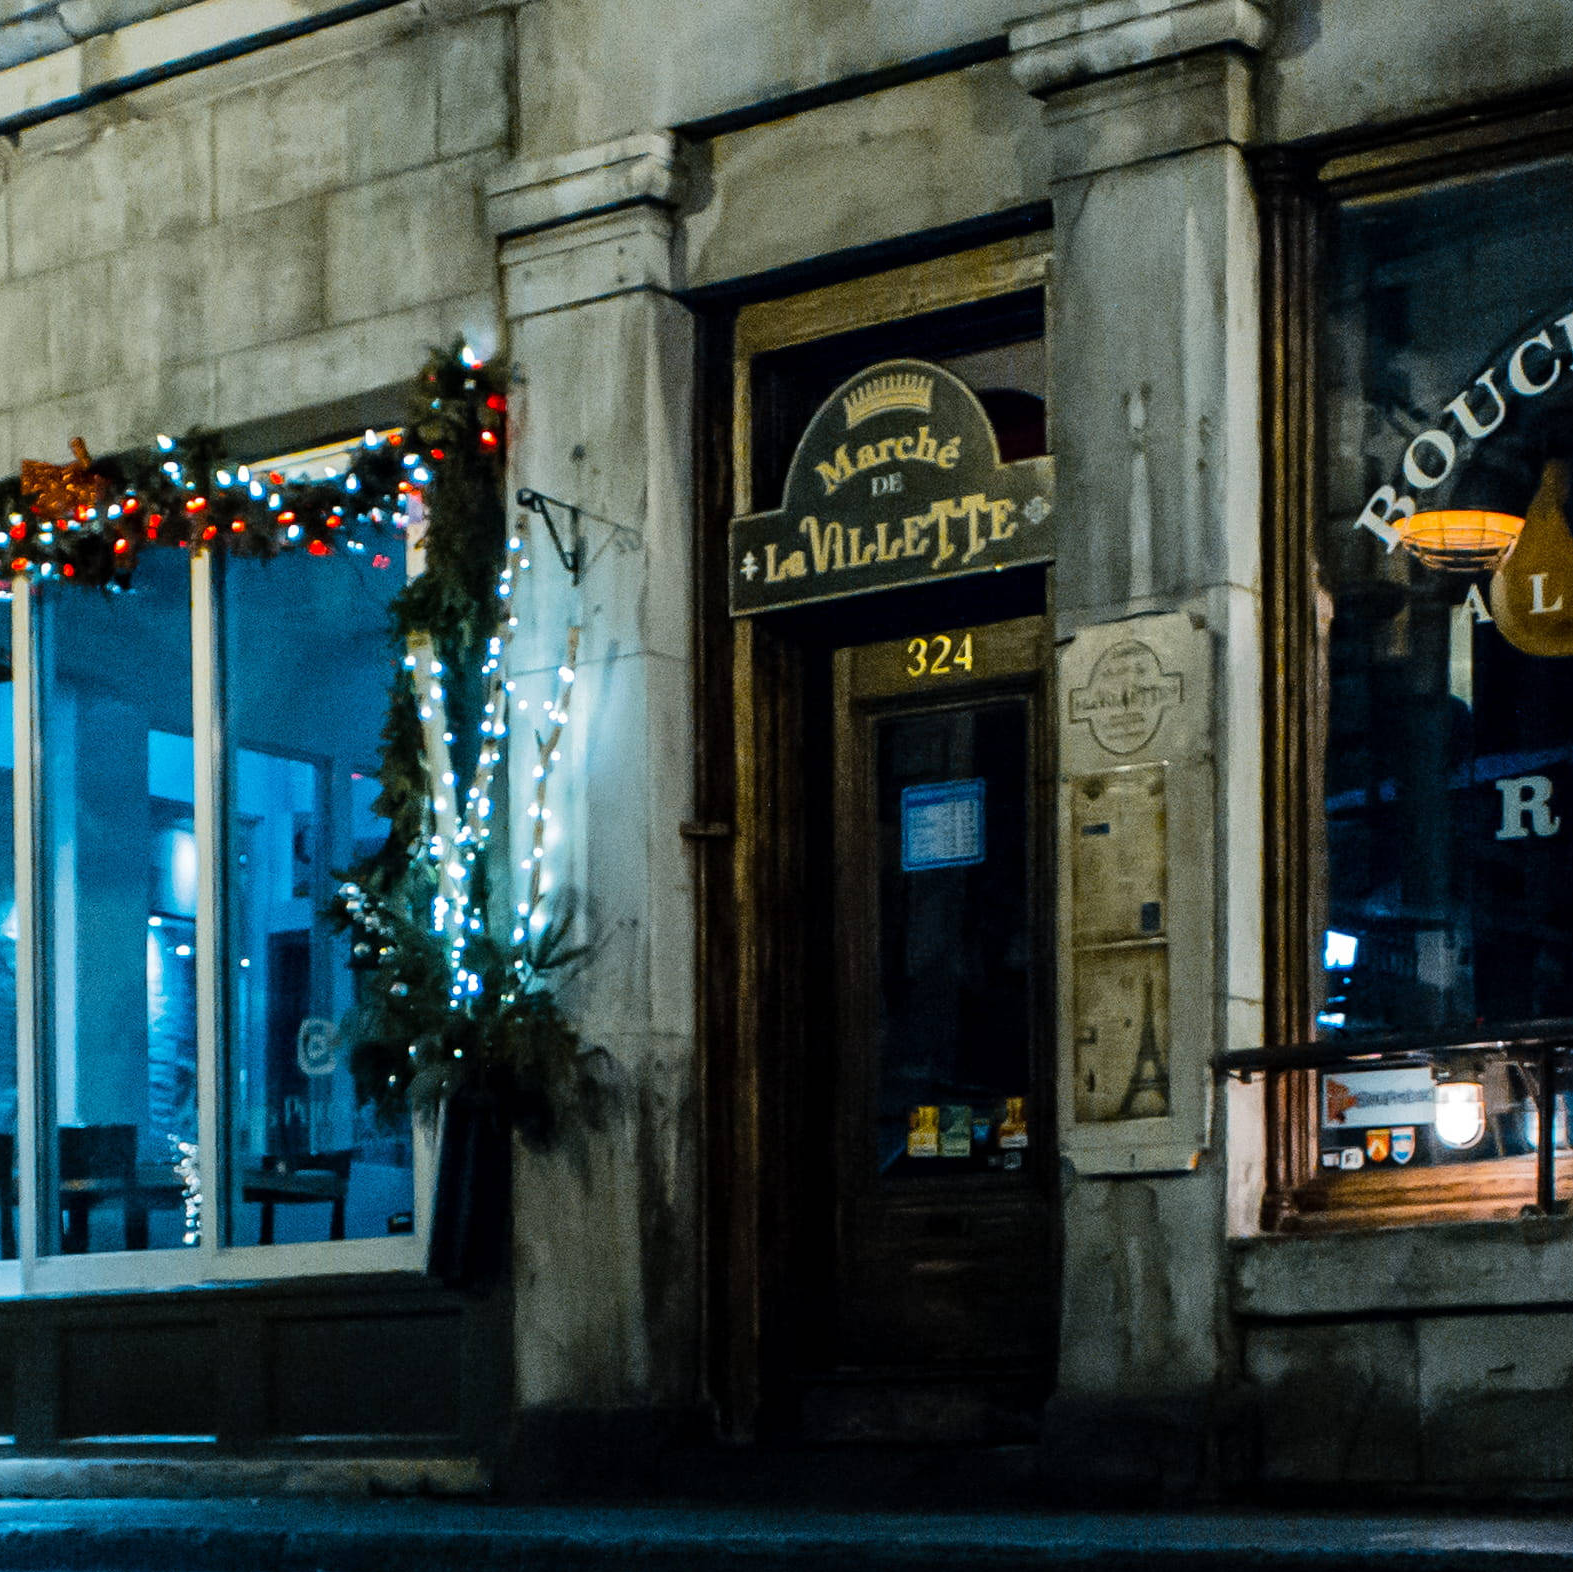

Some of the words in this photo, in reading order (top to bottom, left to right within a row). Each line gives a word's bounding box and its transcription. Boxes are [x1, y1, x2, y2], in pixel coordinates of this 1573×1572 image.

[814, 427, 961, 495] Marché
[870, 472, 903, 496] DE
[905, 633, 974, 677] 324
